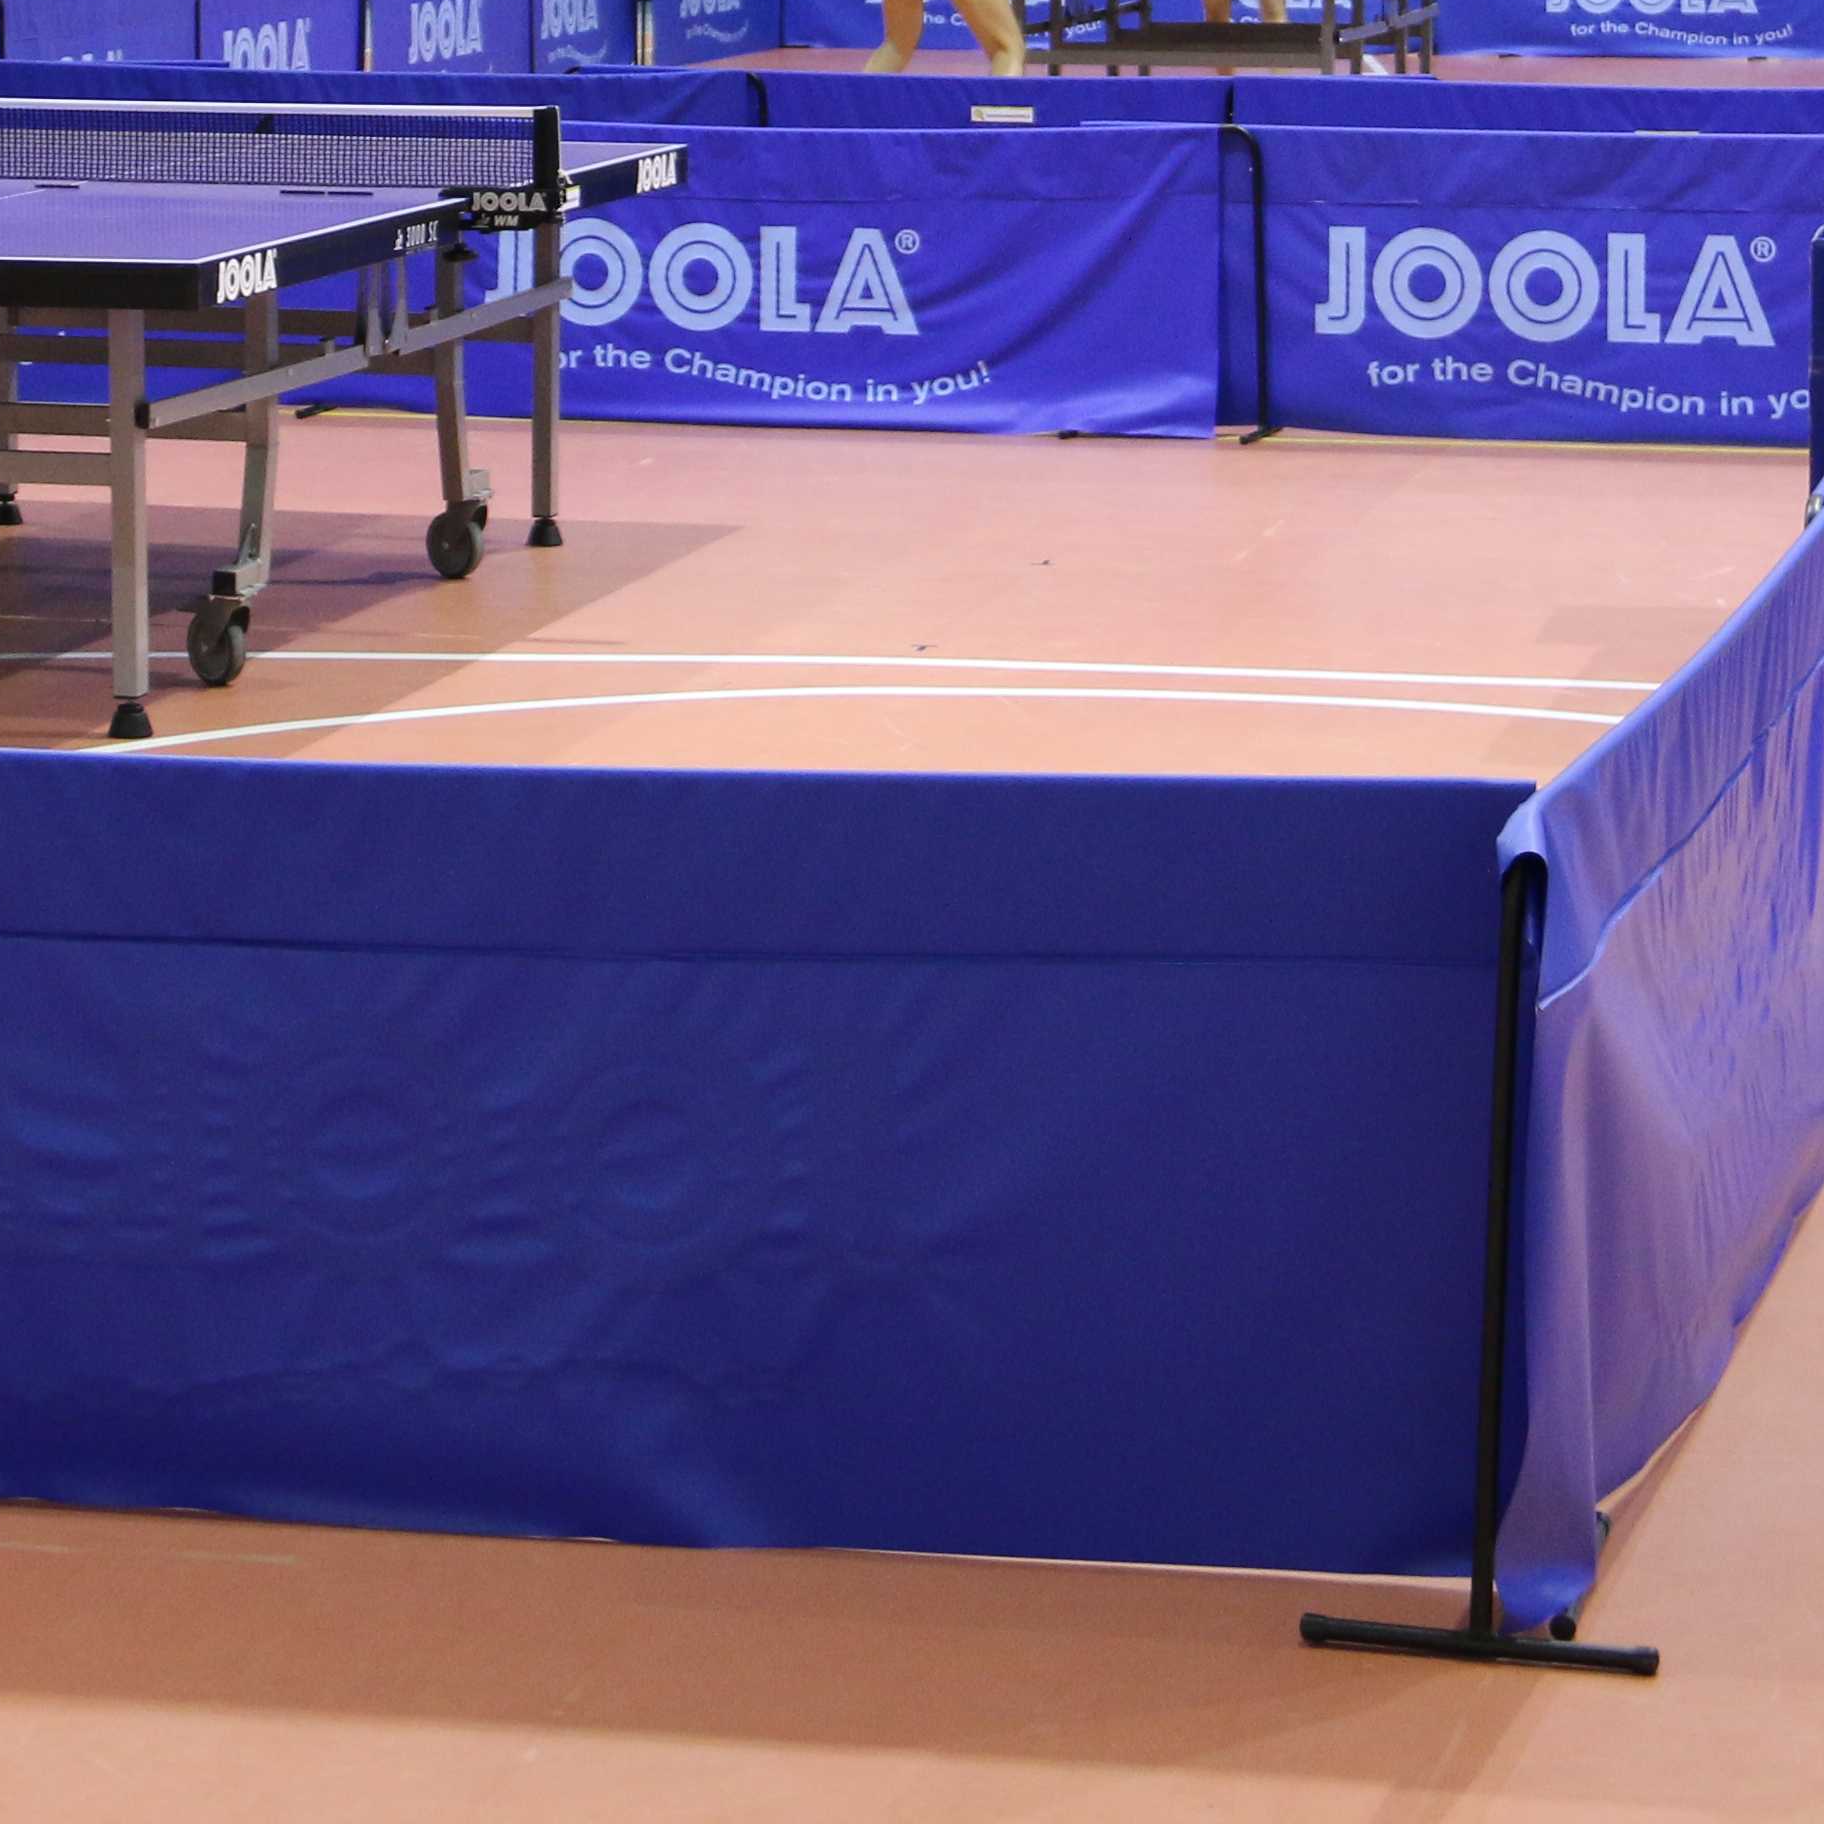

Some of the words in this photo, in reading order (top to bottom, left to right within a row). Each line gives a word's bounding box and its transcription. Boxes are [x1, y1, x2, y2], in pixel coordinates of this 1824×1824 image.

[1571, 22, 1596, 37] for
[1599, 19, 1630, 35] the
[1635, 21, 1728, 47] Champion
[1733, 31, 1749, 45] in
[1755, 23, 1793, 46] you!
[637, 152, 677, 194] JOOLA
[472, 192, 547, 211] JOOLA
[494, 215, 519, 226] WM
[217, 248, 278, 304] JOOLA
[484, 218, 920, 335] JOOLA
[1315, 225, 1775, 346] JOOLA
[595, 342, 651, 369] the
[665, 347, 852, 402] Champion
[866, 377, 898, 402] in
[911, 361, 992, 407] you!
[1368, 360, 1420, 387] for
[1431, 355, 1493, 383] the
[1507, 359, 1705, 416] Champion
[1720, 389, 1754, 416] in
[1768, 388, 1811, 419] yo
